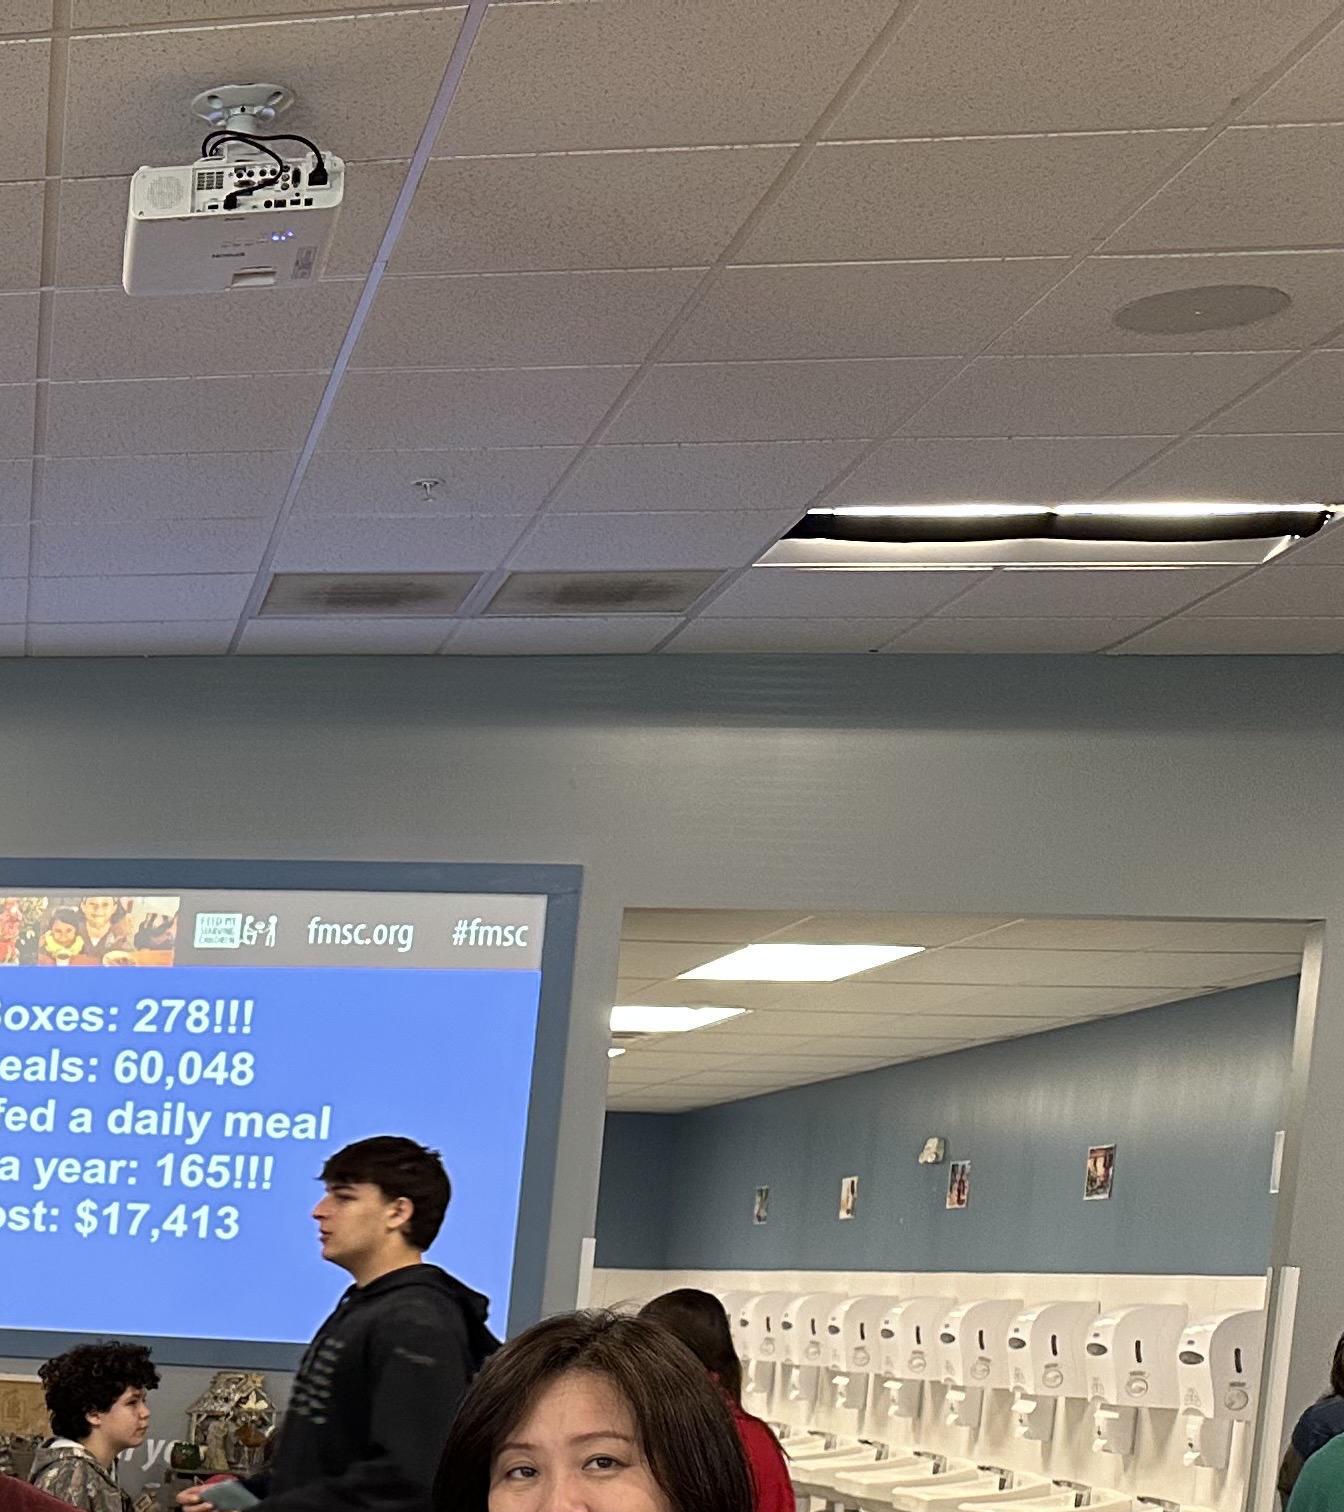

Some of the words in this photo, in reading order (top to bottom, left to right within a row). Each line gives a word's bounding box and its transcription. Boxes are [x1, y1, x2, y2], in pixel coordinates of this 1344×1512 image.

[307, 916, 414, 953] fmsc.org
[451, 917, 529, 947] #fmsc
[133, 998, 254, 1034] 278!!!
[114, 1049, 255, 1091] 60,048
[68, 1107, 92, 1133] a
[107, 1101, 211, 1145] daily
[224, 1105, 331, 1140] meal
[33, 1157, 138, 1191] year:
[156, 1152, 274, 1190] 165!!!
[74, 1198, 239, 1243] $17,413
